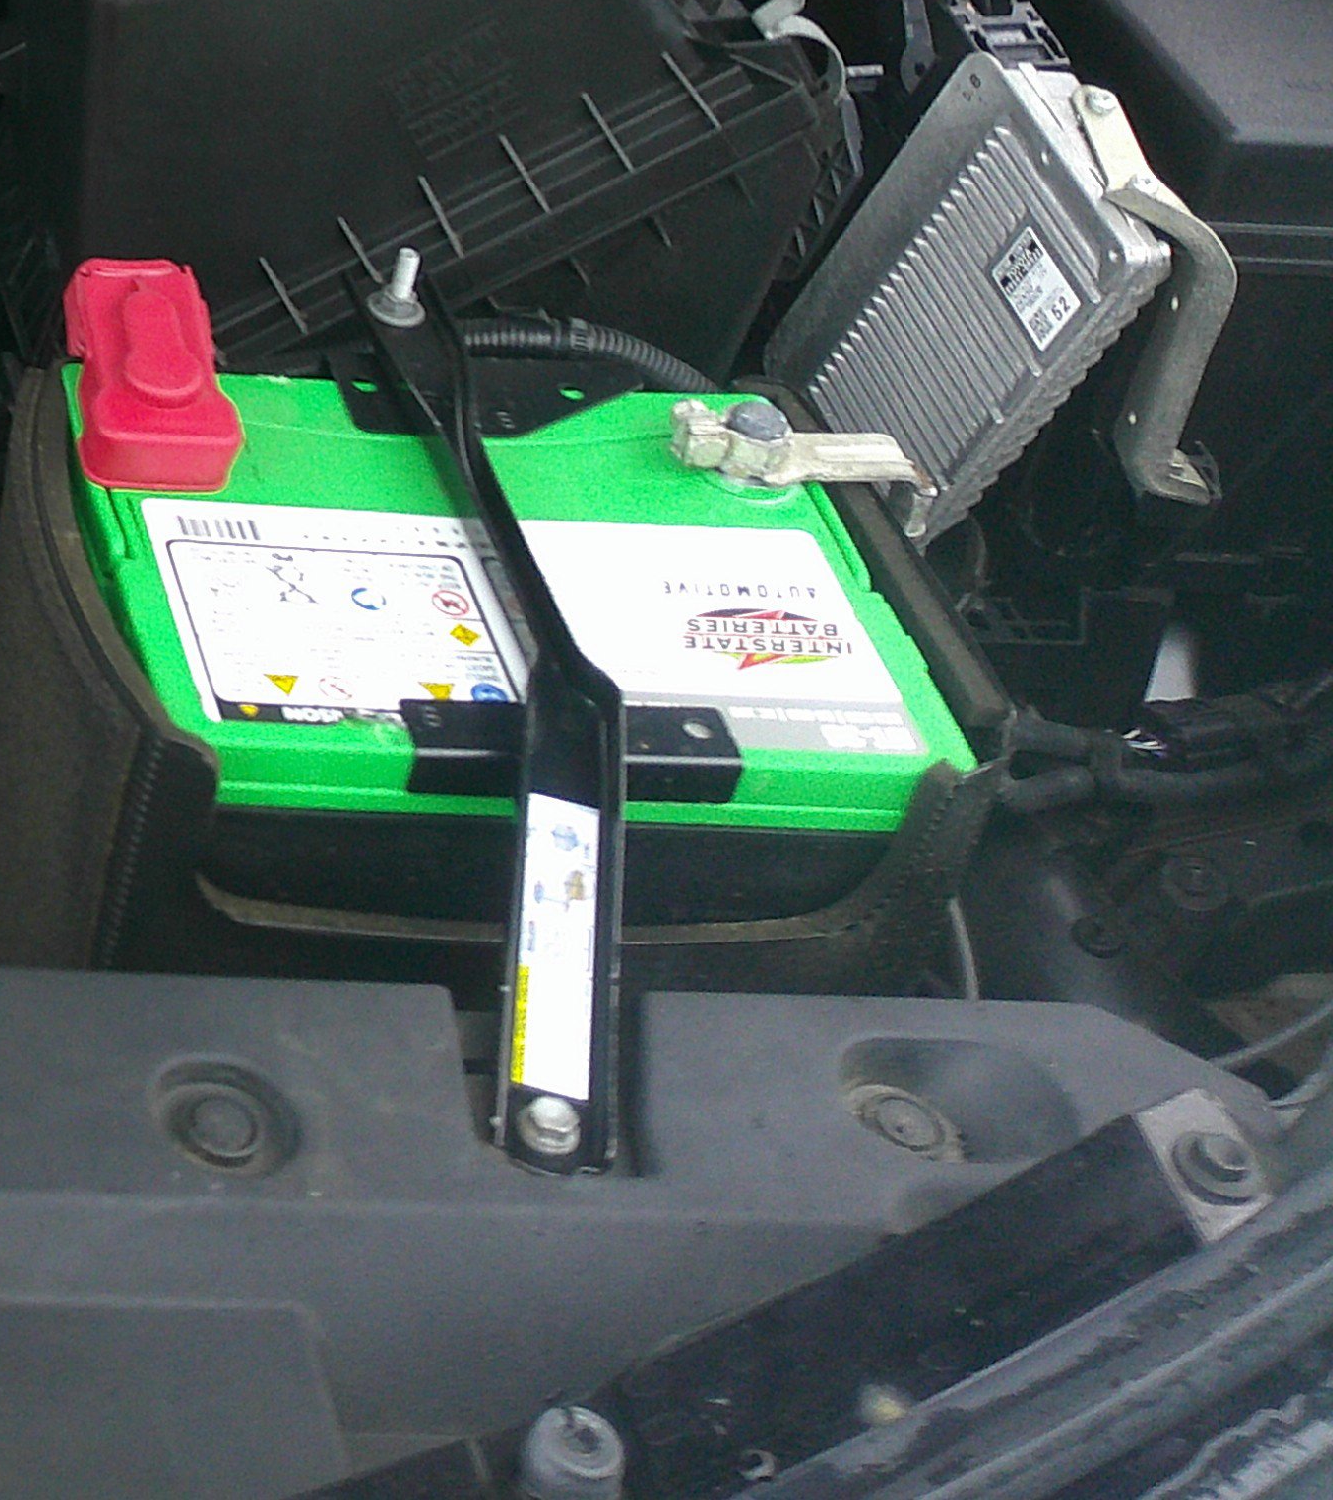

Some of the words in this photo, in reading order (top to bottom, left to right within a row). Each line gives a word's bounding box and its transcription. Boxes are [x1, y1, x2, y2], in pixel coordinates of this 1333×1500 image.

[664, 581, 815, 599] AUTOMOTIVE
[687, 618, 838, 637] BATTERIES
[685, 635, 851, 654] INTERSTATE
